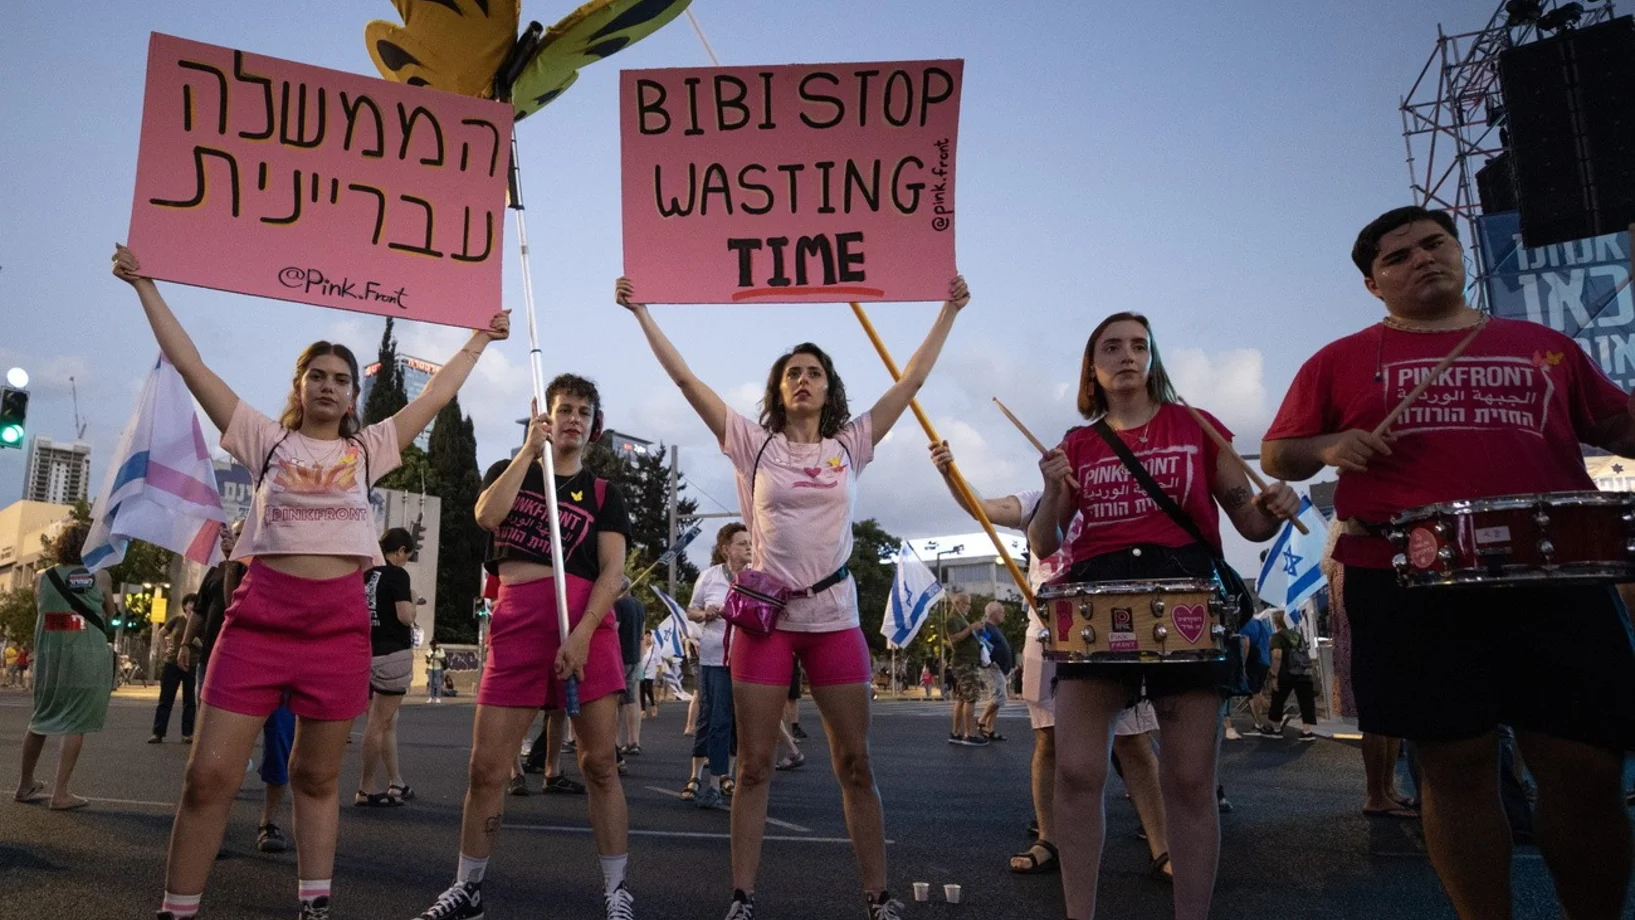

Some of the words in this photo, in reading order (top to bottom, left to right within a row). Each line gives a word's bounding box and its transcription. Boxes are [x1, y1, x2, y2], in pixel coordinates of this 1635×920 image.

[178, 50, 500, 177] הממשלה
[636, 71, 776, 136] BIBI
[799, 67, 954, 129] STOP
[149, 145, 492, 262] עבריינית
[655, 155, 926, 218] WASTING
[931, 138, 954, 232] @pink.front
[278, 266, 408, 310] @Pink.Front
[727, 231, 865, 287] TIME
[1518, 264, 1635, 333] כאן
[1474, 408, 1535, 427] החזית
[272, 507, 367, 522] PINKFRONT
